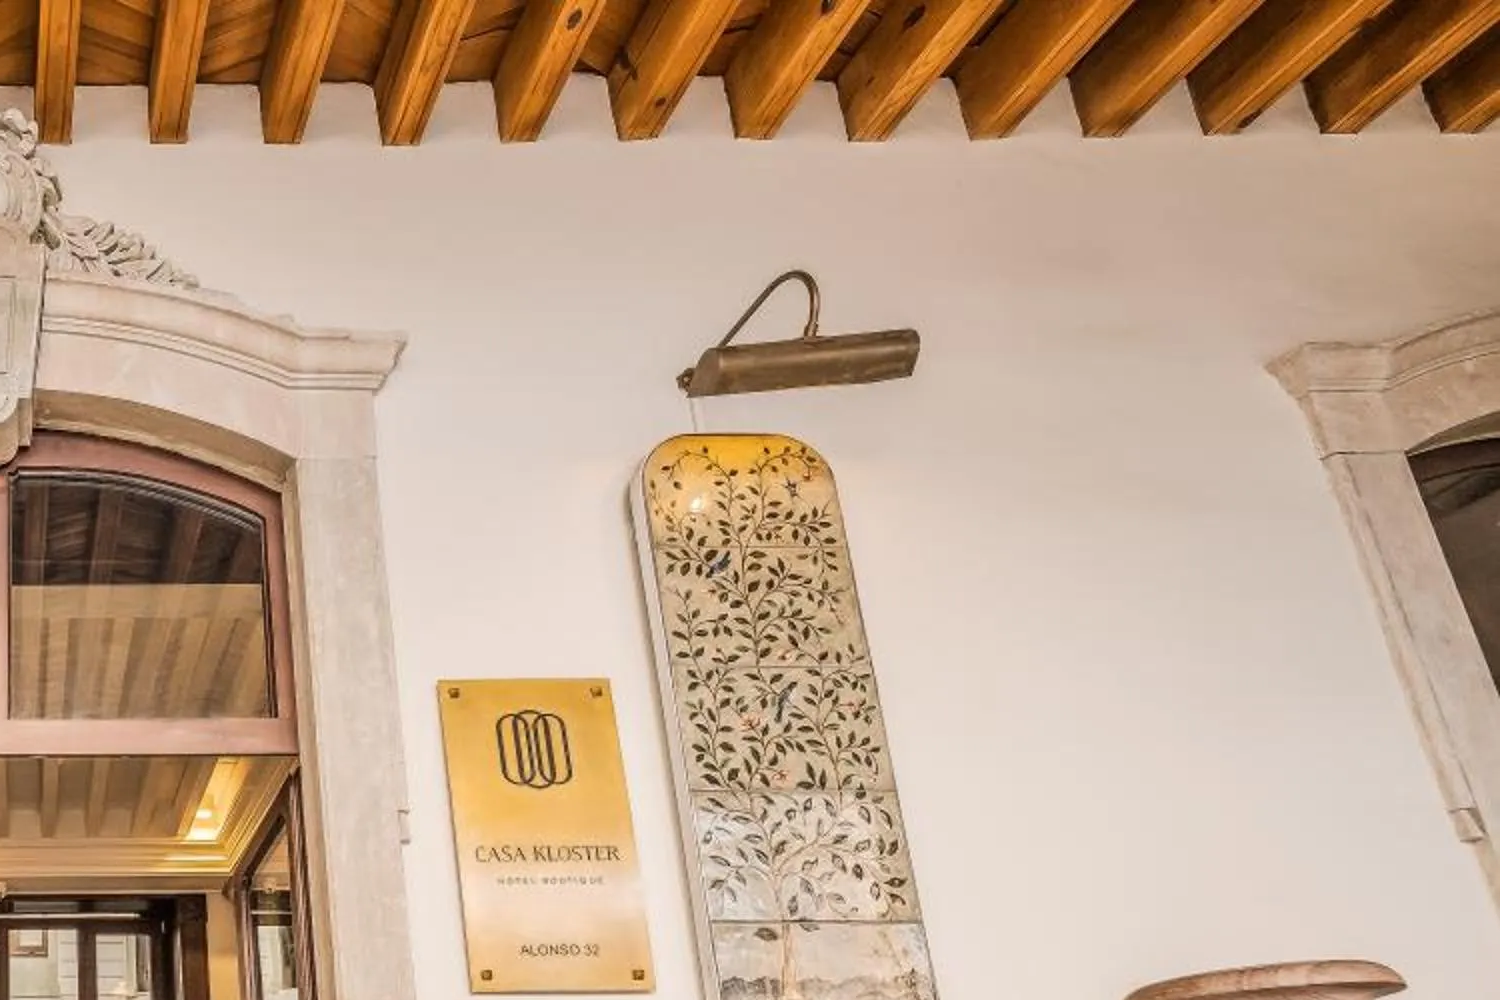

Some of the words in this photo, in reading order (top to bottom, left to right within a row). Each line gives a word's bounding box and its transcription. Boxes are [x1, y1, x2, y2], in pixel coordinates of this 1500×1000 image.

[475, 845, 526, 862] CASA
[533, 845, 621, 862] KLOSTER
[497, 876, 536, 886] HOTEL
[542, 875, 605, 886] BOUTIQUE
[520, 944, 581, 957] ALONSO
[584, 943, 600, 956] 32
